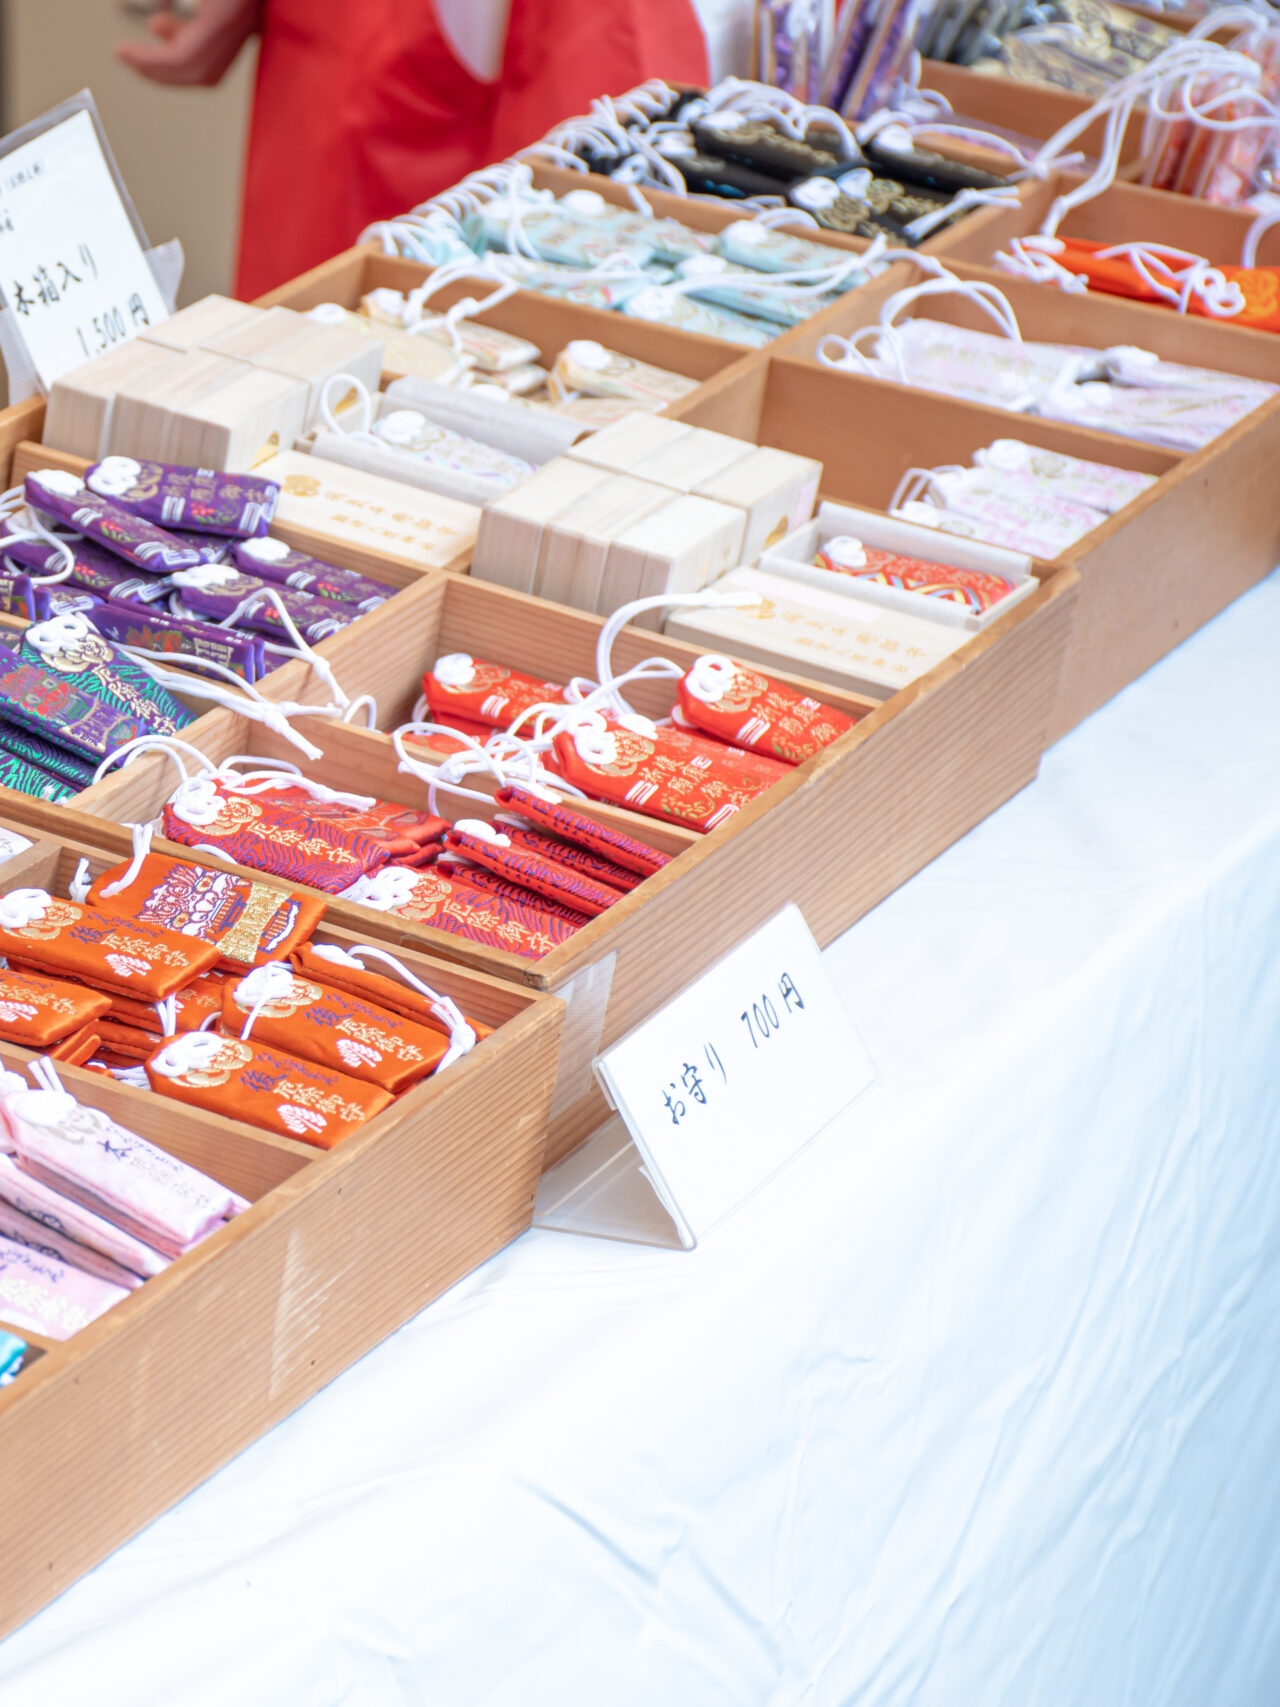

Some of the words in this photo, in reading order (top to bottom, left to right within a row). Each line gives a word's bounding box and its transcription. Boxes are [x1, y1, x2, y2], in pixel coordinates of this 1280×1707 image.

[13, 243, 98, 316] 木箱入り
[91, 663, 177, 736] 厄除御守
[246, 820, 358, 864] 厄除御守
[442, 898, 556, 953] 厄除御守
[662, 1041, 727, 1125] お守り
[740, 972, 805, 1048] 700円
